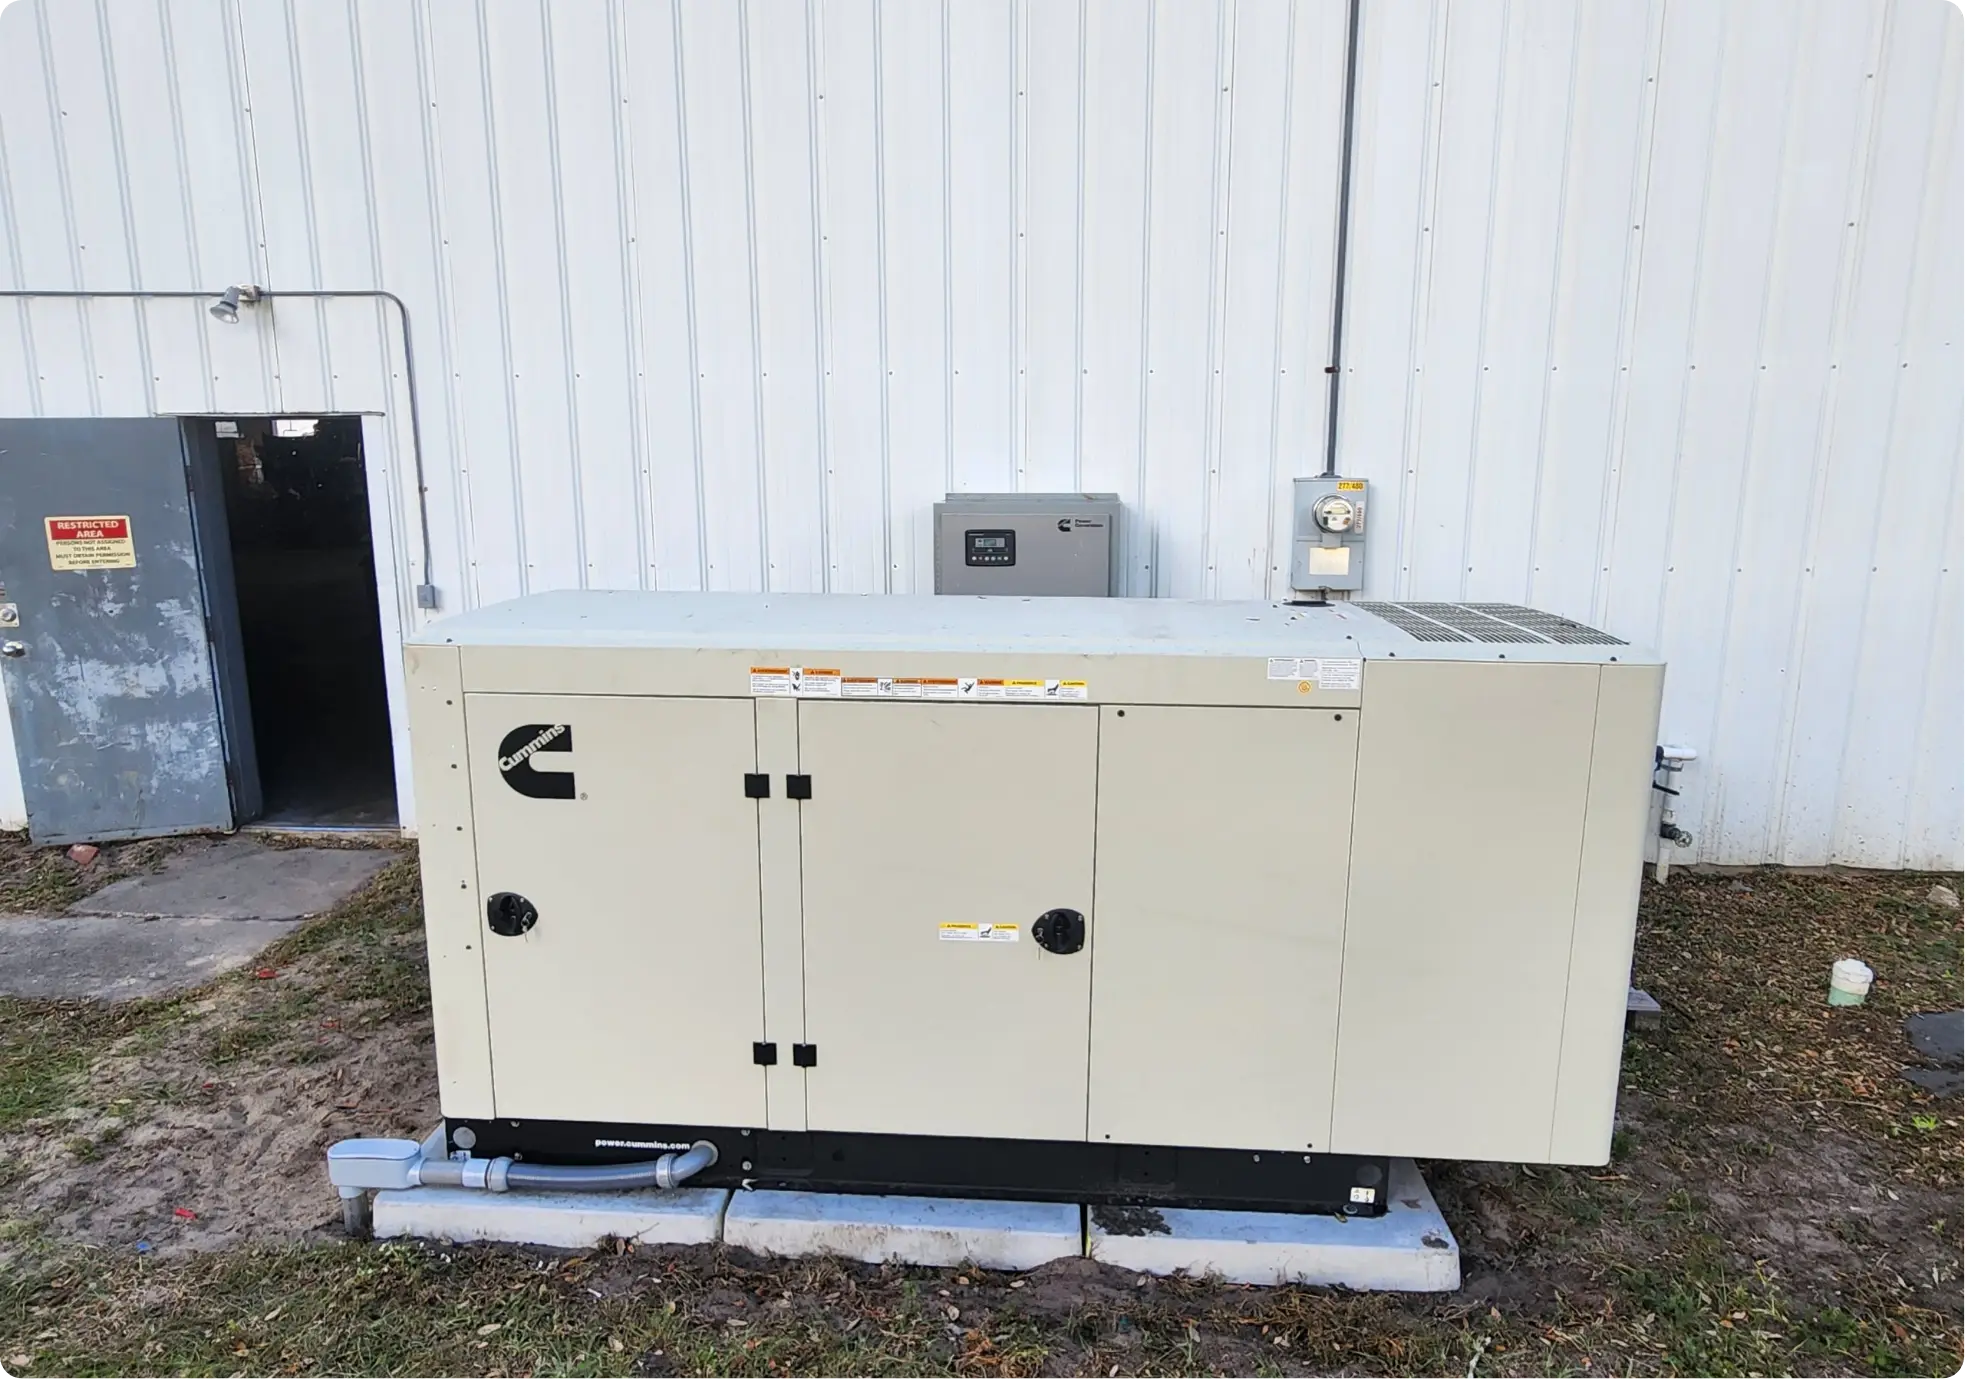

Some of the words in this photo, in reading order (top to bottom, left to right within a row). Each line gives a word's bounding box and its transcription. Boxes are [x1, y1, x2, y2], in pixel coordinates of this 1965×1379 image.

[57, 520, 119, 529] RESTRICTED
[76, 530, 104, 538] AREA
[498, 723, 566, 772] Cummins
[595, 1139, 691, 1150] power.cummins.com
